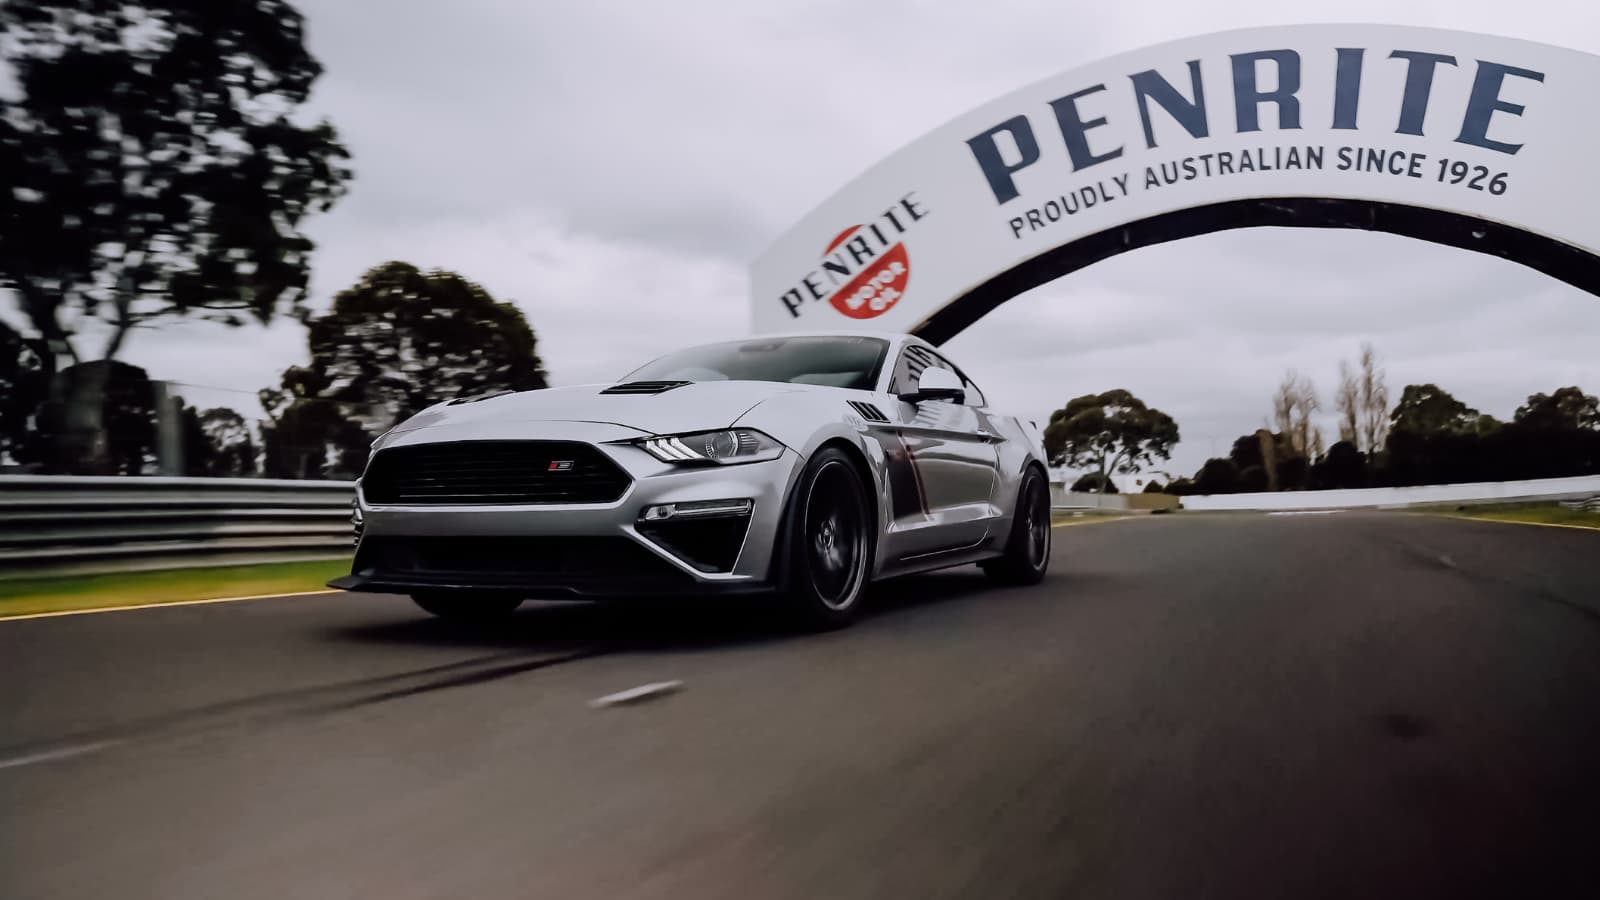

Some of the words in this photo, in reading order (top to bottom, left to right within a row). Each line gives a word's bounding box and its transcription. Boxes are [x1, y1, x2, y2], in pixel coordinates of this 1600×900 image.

[965, 47, 1545, 204] PENRITE
[1009, 173, 1129, 239] PROUDLY
[1144, 146, 1324, 190] AUSTRALIAN
[1336, 147, 1426, 178] SINCE
[1437, 157, 1509, 196] 1926
[779, 191, 931, 318] PENRITE
[846, 261, 907, 310] MOTOR
[869, 287, 901, 311] OIL
